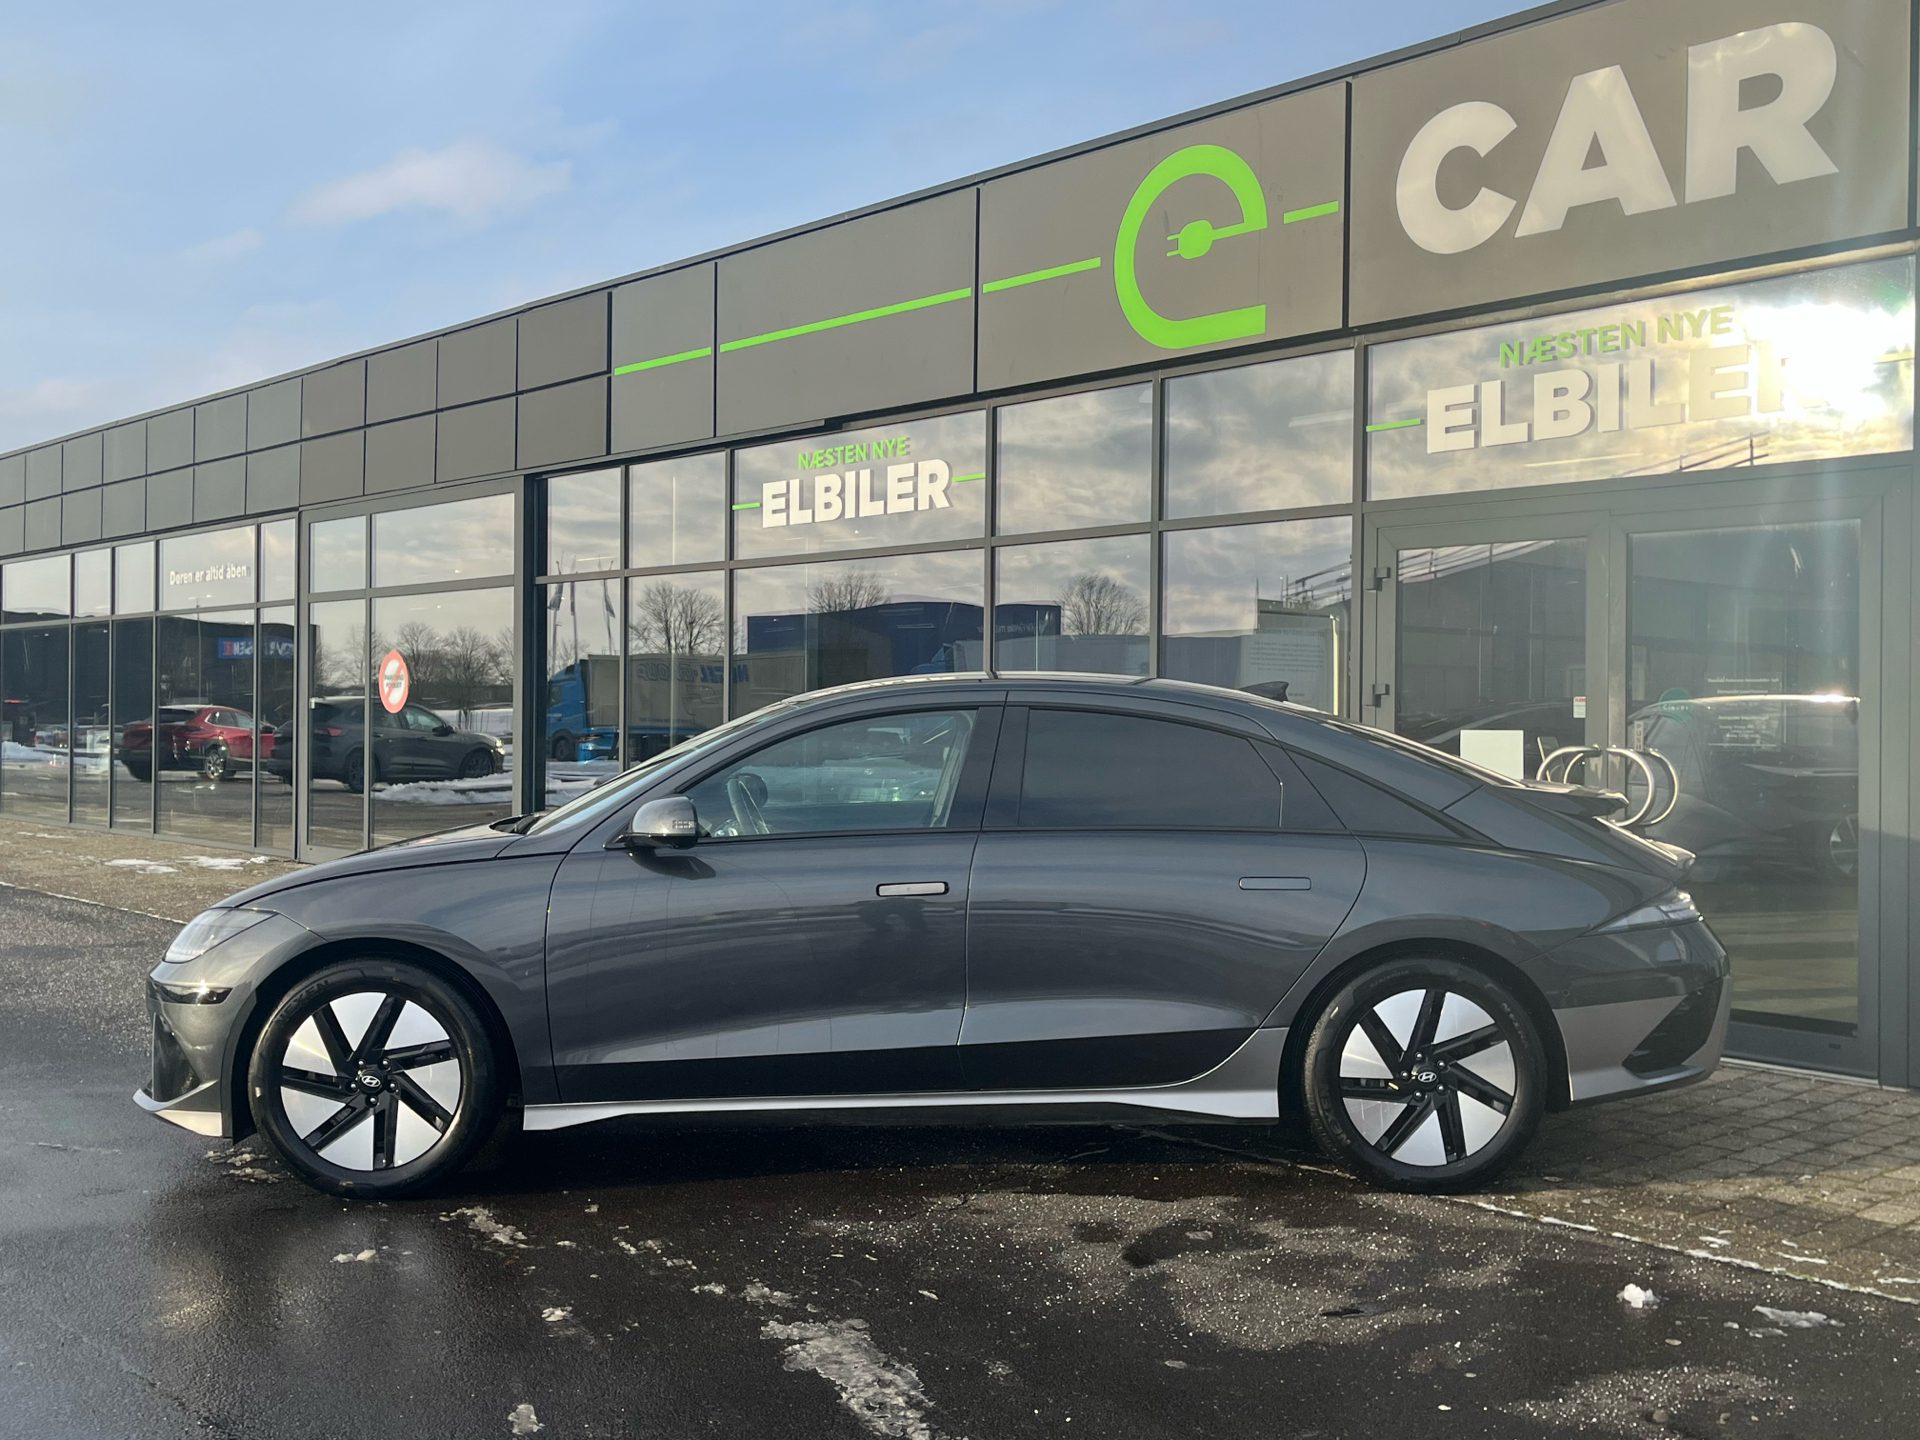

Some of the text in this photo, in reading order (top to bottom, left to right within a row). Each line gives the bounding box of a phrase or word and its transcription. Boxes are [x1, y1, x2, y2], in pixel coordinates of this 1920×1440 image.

[1395, 21, 1839, 254] CAR
[1499, 305, 1733, 368] NÆSTEN NYE
[798, 436, 909, 470] NÆSTEN NYE
[762, 458, 951, 529] ELBILER
[195, 570, 204, 582] er
[205, 565, 224, 582] altid
